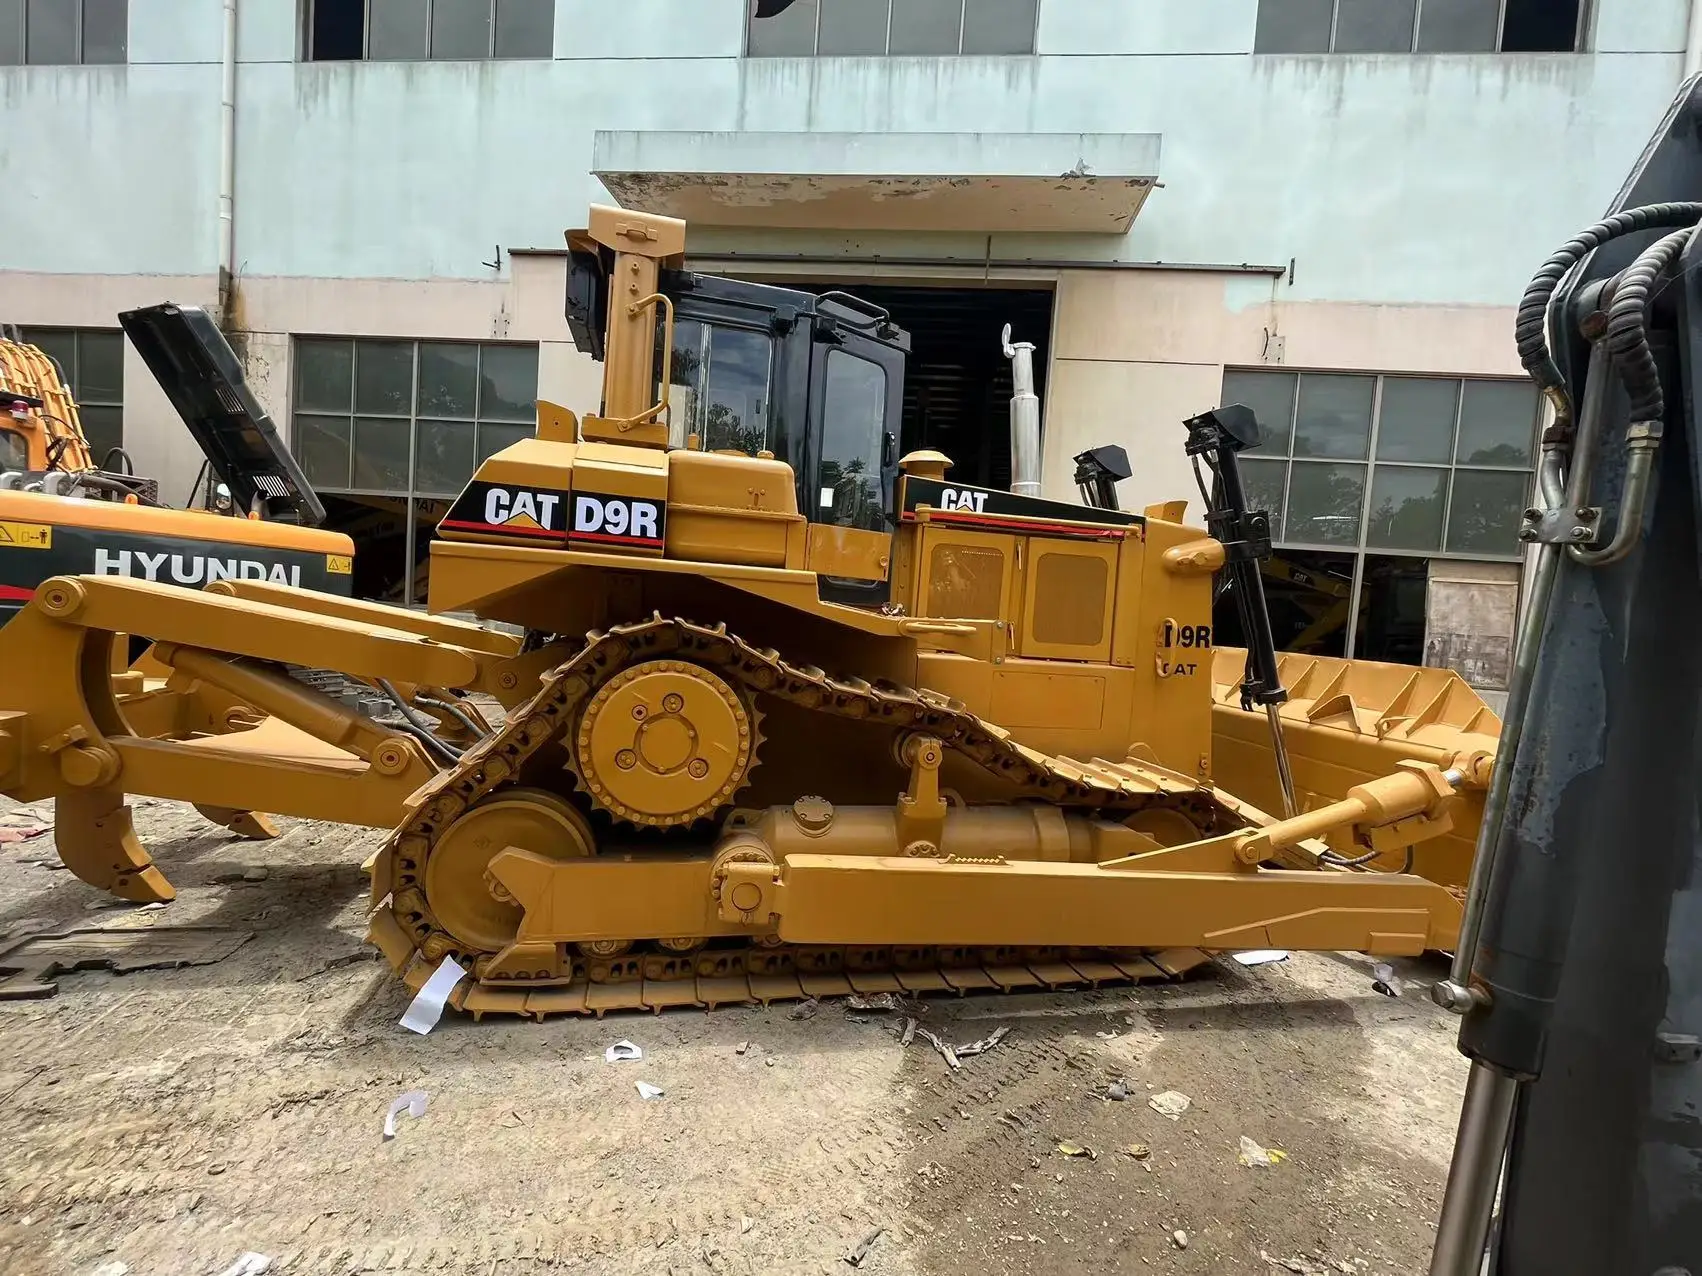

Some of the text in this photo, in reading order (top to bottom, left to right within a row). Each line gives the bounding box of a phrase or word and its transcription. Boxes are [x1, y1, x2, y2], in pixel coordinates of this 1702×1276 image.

[485, 488, 559, 531] CAT
[575, 496, 658, 538] D9R
[941, 488, 989, 513] CAT
[95, 548, 301, 589] HYUNDAI
